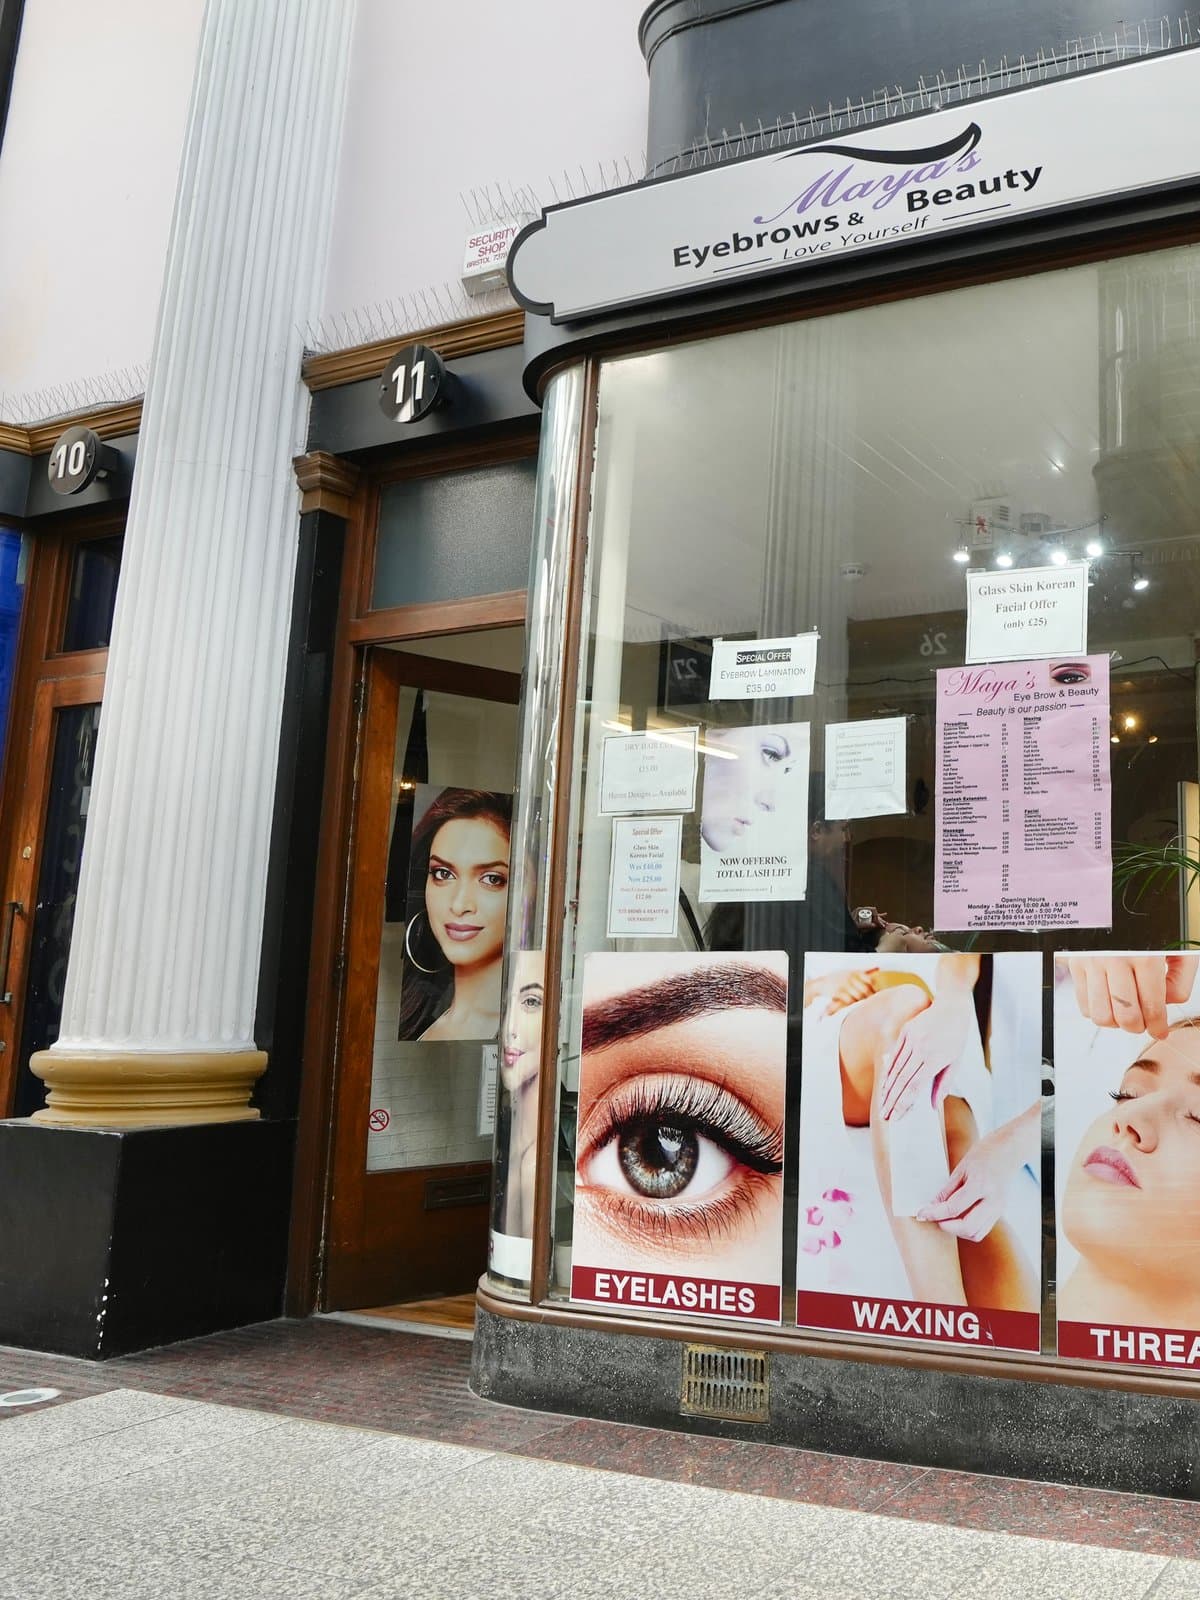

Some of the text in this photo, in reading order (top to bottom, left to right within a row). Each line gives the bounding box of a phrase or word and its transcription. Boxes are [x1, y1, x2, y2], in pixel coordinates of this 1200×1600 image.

[754, 149, 982, 224] Maya's
[673, 165, 1043, 269] Eyebrows & Beauty
[469, 227, 517, 248] SECURITY
[782, 214, 931, 261] Love Yourself
[478, 242, 506, 257] SHOP
[391, 360, 425, 404] 11
[56, 441, 86, 478] 10
[978, 580, 1076, 596] Glass Skin Korean
[995, 599, 1058, 613] Facial Offer
[1003, 617, 1048, 630] (only £25)
[1014, 693, 1031, 702] Eye
[1034, 692, 1056, 700] Brow
[1068, 687, 1099, 697] Beauty
[976, 707, 1006, 717] Beauty
[1008, 706, 1016, 714] is
[1034, 702, 1067, 714] passion
[720, 856, 787, 866] NOW OFFERING
[716, 868, 792, 878] TOTAL LASH LIFT
[595, 1272, 756, 1314] EYELASHES
[852, 1300, 980, 1340] WAXING
